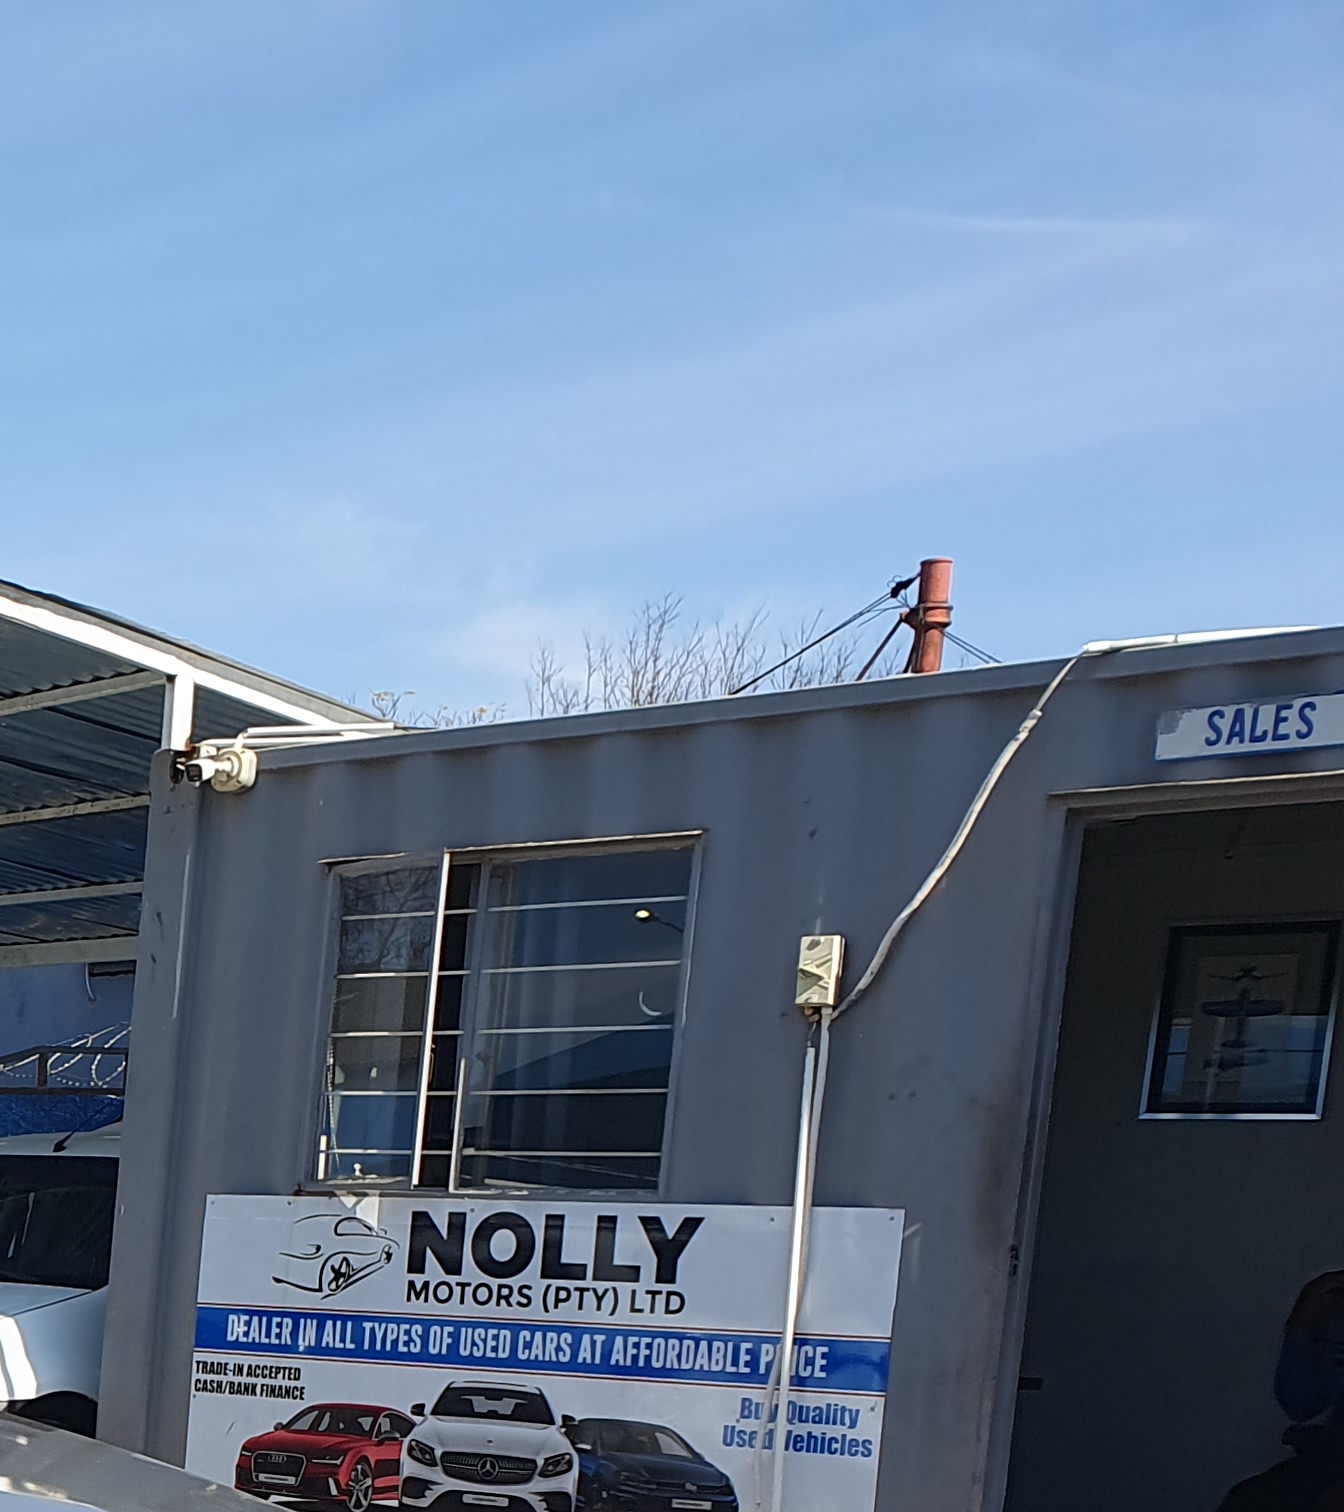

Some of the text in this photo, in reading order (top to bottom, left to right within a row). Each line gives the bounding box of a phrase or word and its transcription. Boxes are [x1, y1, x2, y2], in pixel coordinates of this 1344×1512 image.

[1204, 701, 1317, 747] SALES
[406, 1210, 706, 1284] NOLLY
[406, 1279, 686, 1316] MOTORS (PTY) LTD
[226, 1314, 830, 1378] DEALER IN ALL TYPES OF USED CARS AT AFFORDABLE PICE
[194, 1360, 302, 1381] TRADE-IN ACCEPTED
[194, 1378, 306, 1401] CASH/BANK FINANCE
[786, 1400, 861, 1429] Quality
[722, 1424, 775, 1450] Used
